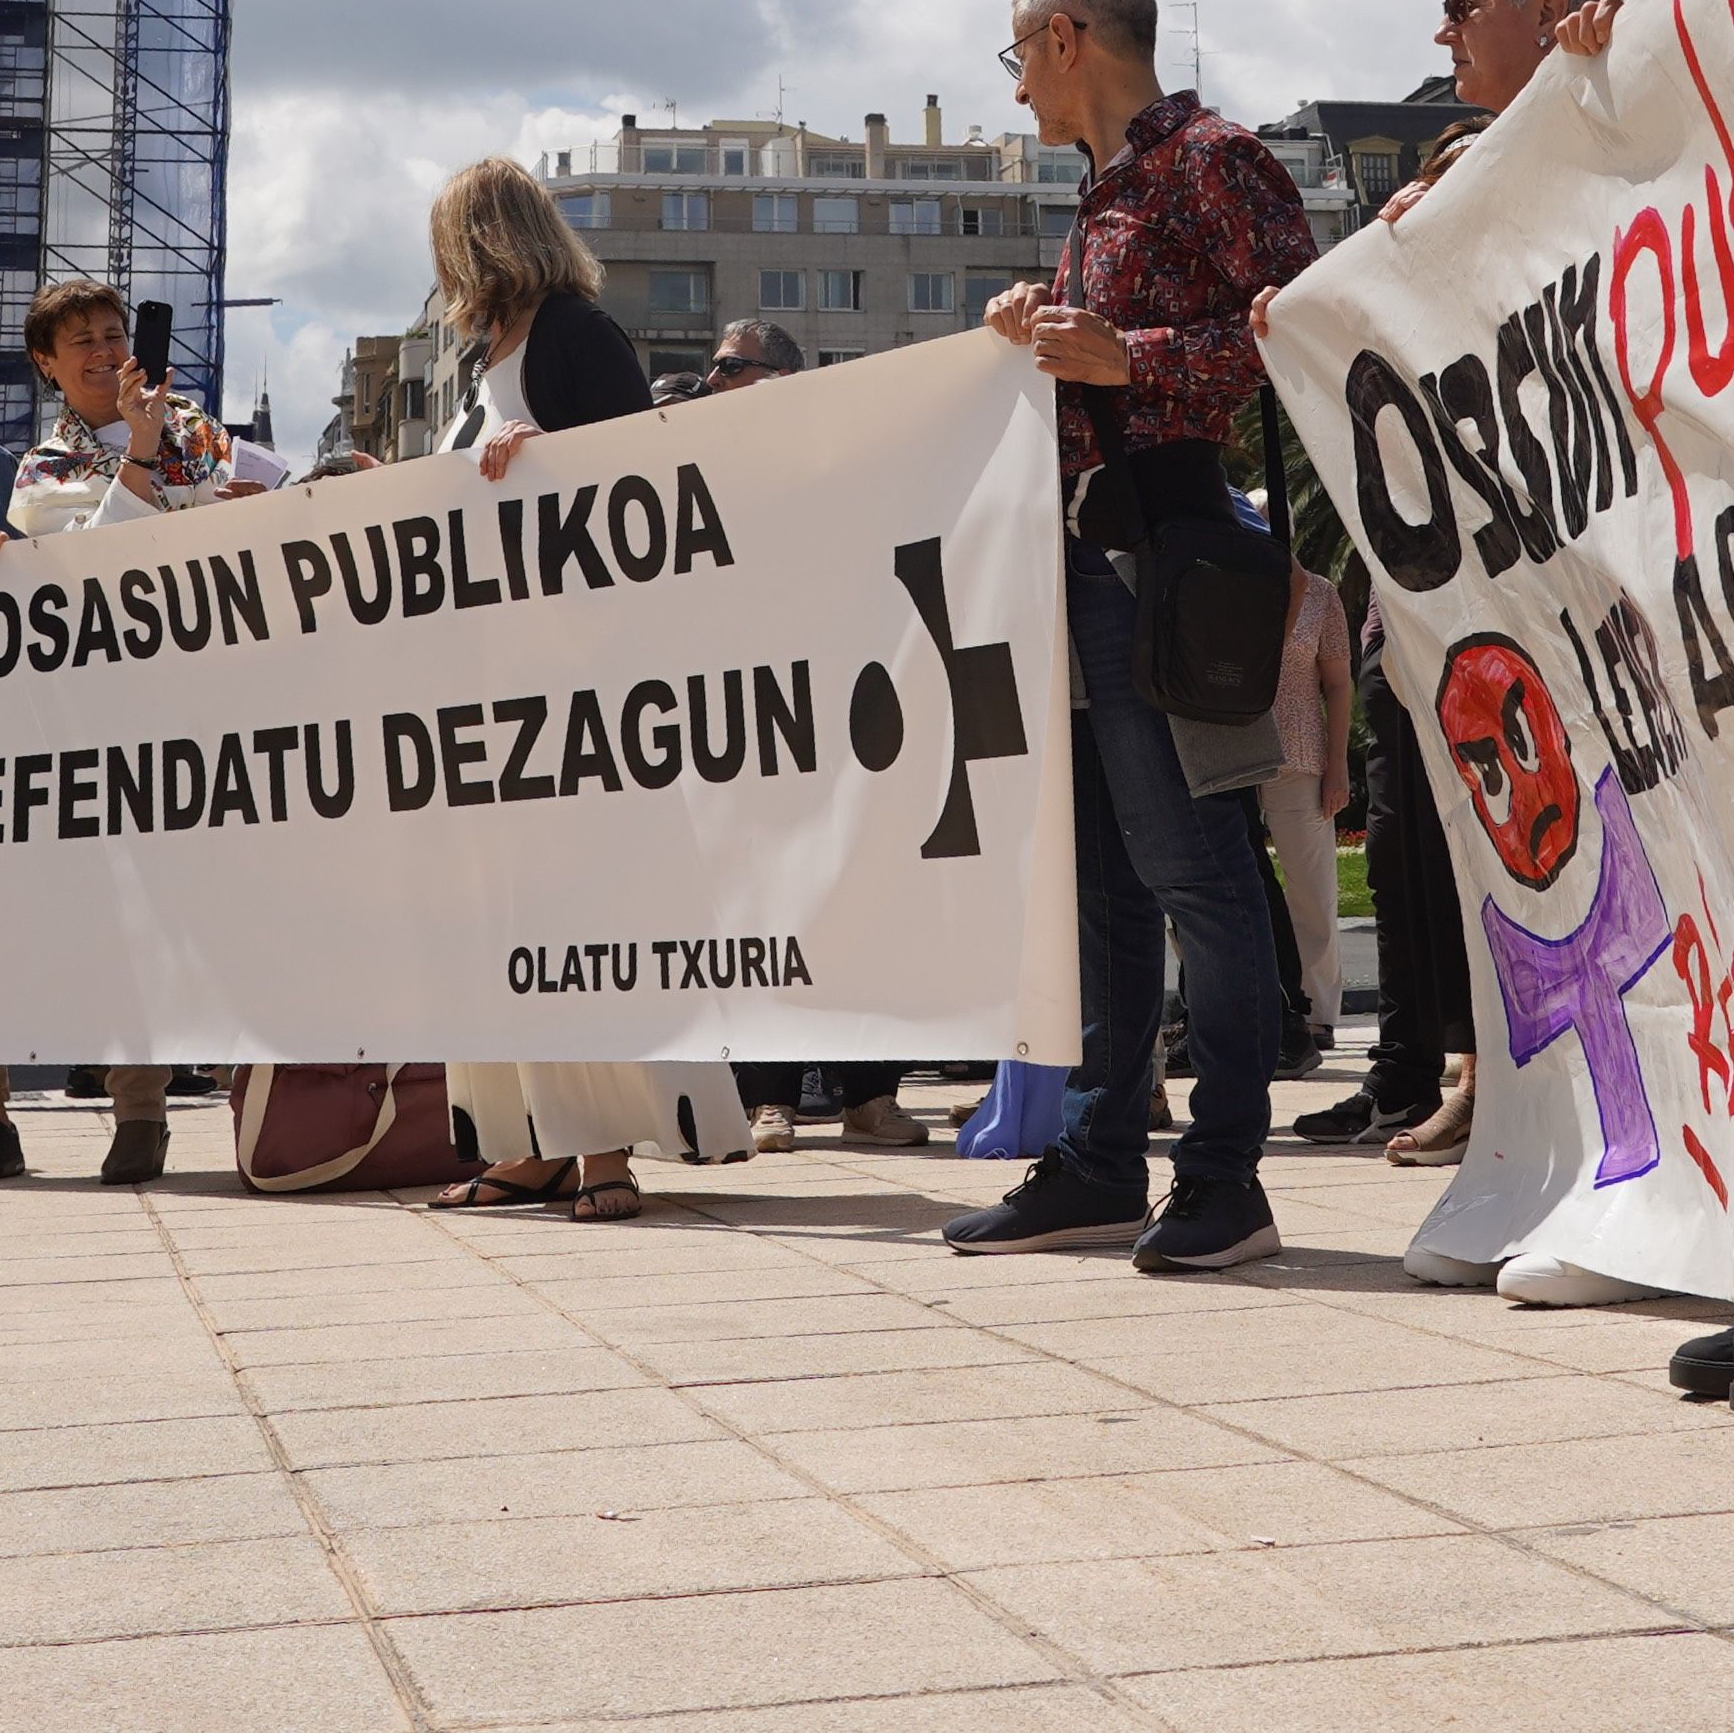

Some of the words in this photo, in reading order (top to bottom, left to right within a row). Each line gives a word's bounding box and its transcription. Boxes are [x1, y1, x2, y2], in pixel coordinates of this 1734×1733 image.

[281, 463, 734, 634] PUBLIKOA
[383, 660, 816, 811] DEZAGUN
[509, 943, 636, 994] OLATU
[652, 937, 812, 989] TXURIA
